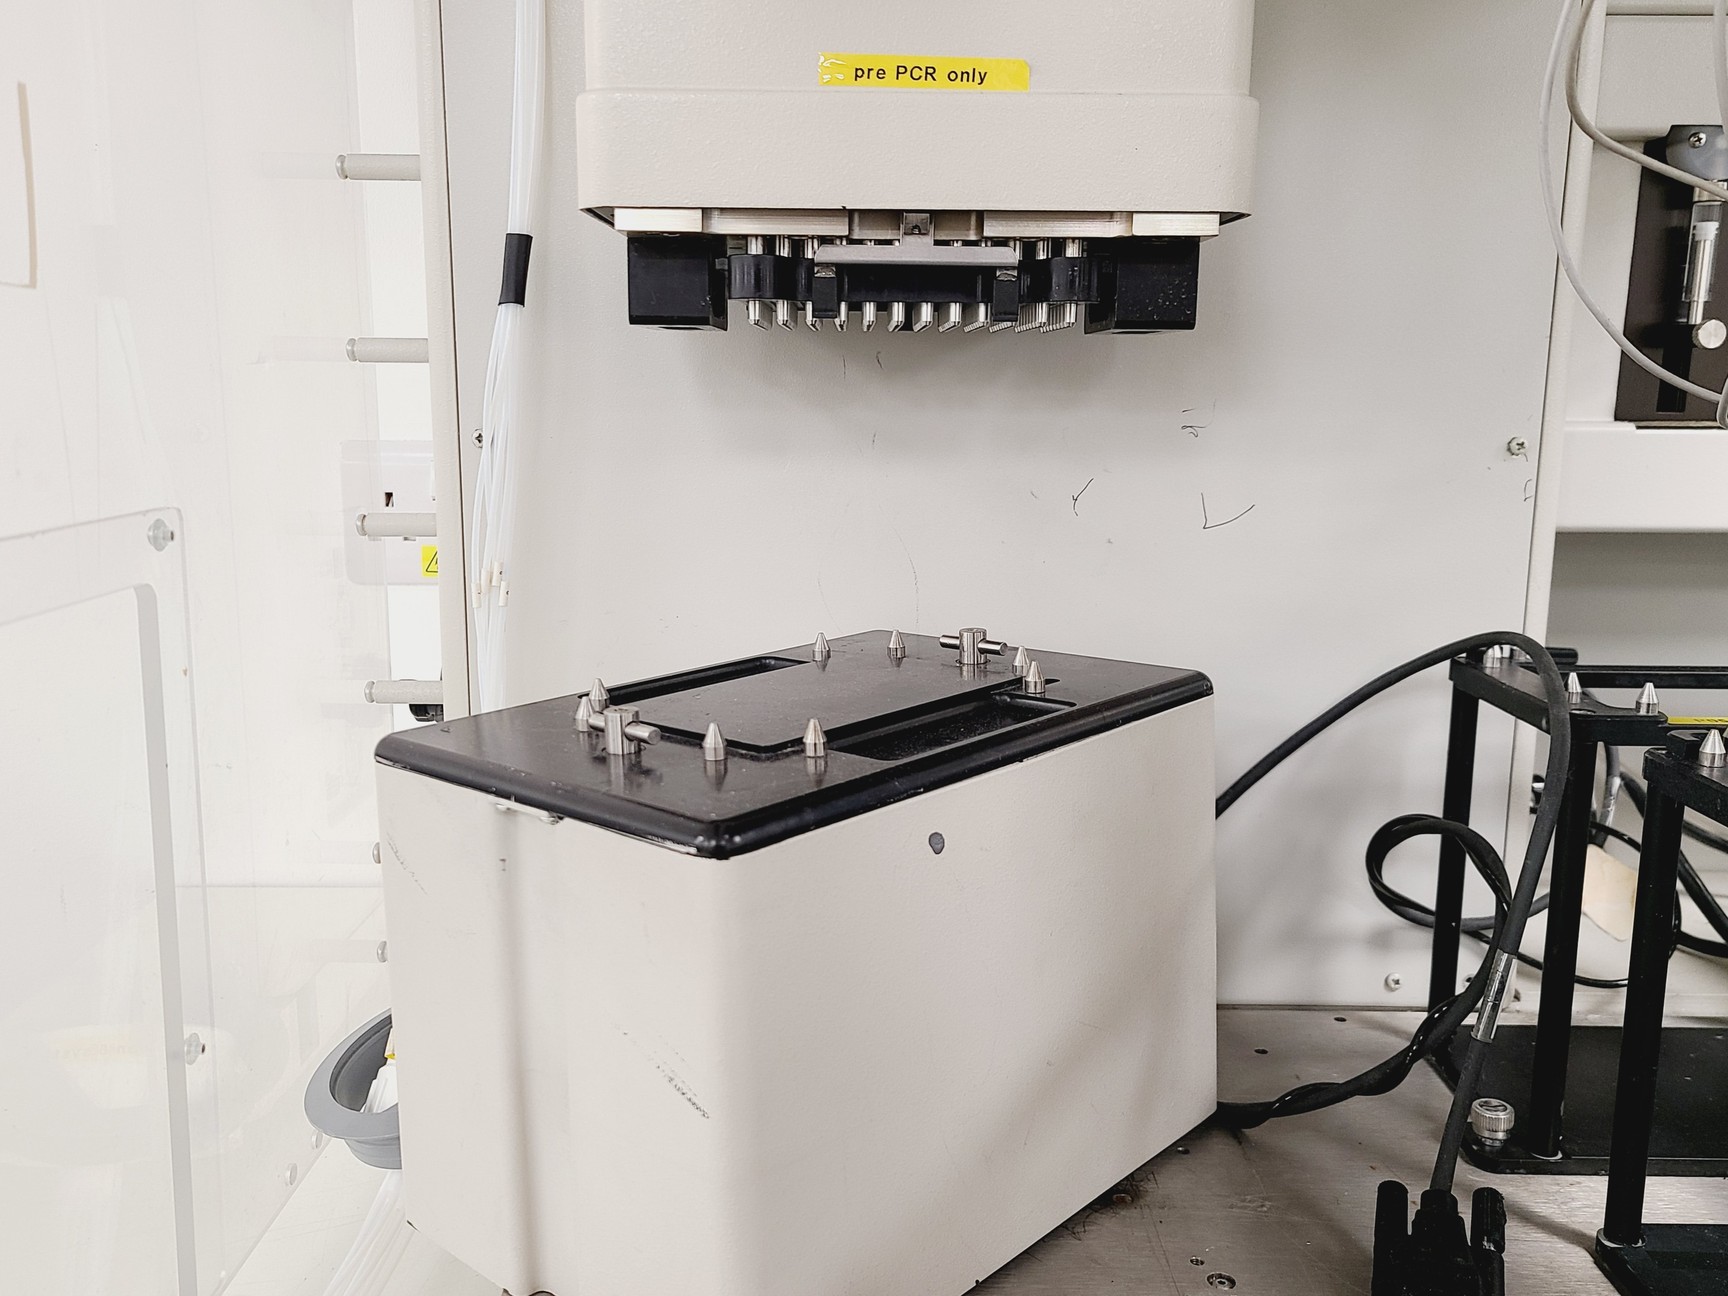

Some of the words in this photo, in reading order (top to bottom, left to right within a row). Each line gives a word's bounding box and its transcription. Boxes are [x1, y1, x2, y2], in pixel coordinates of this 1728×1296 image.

[854, 67, 886, 81] pre
[895, 65, 937, 82] PCR
[947, 68, 988, 86] only
